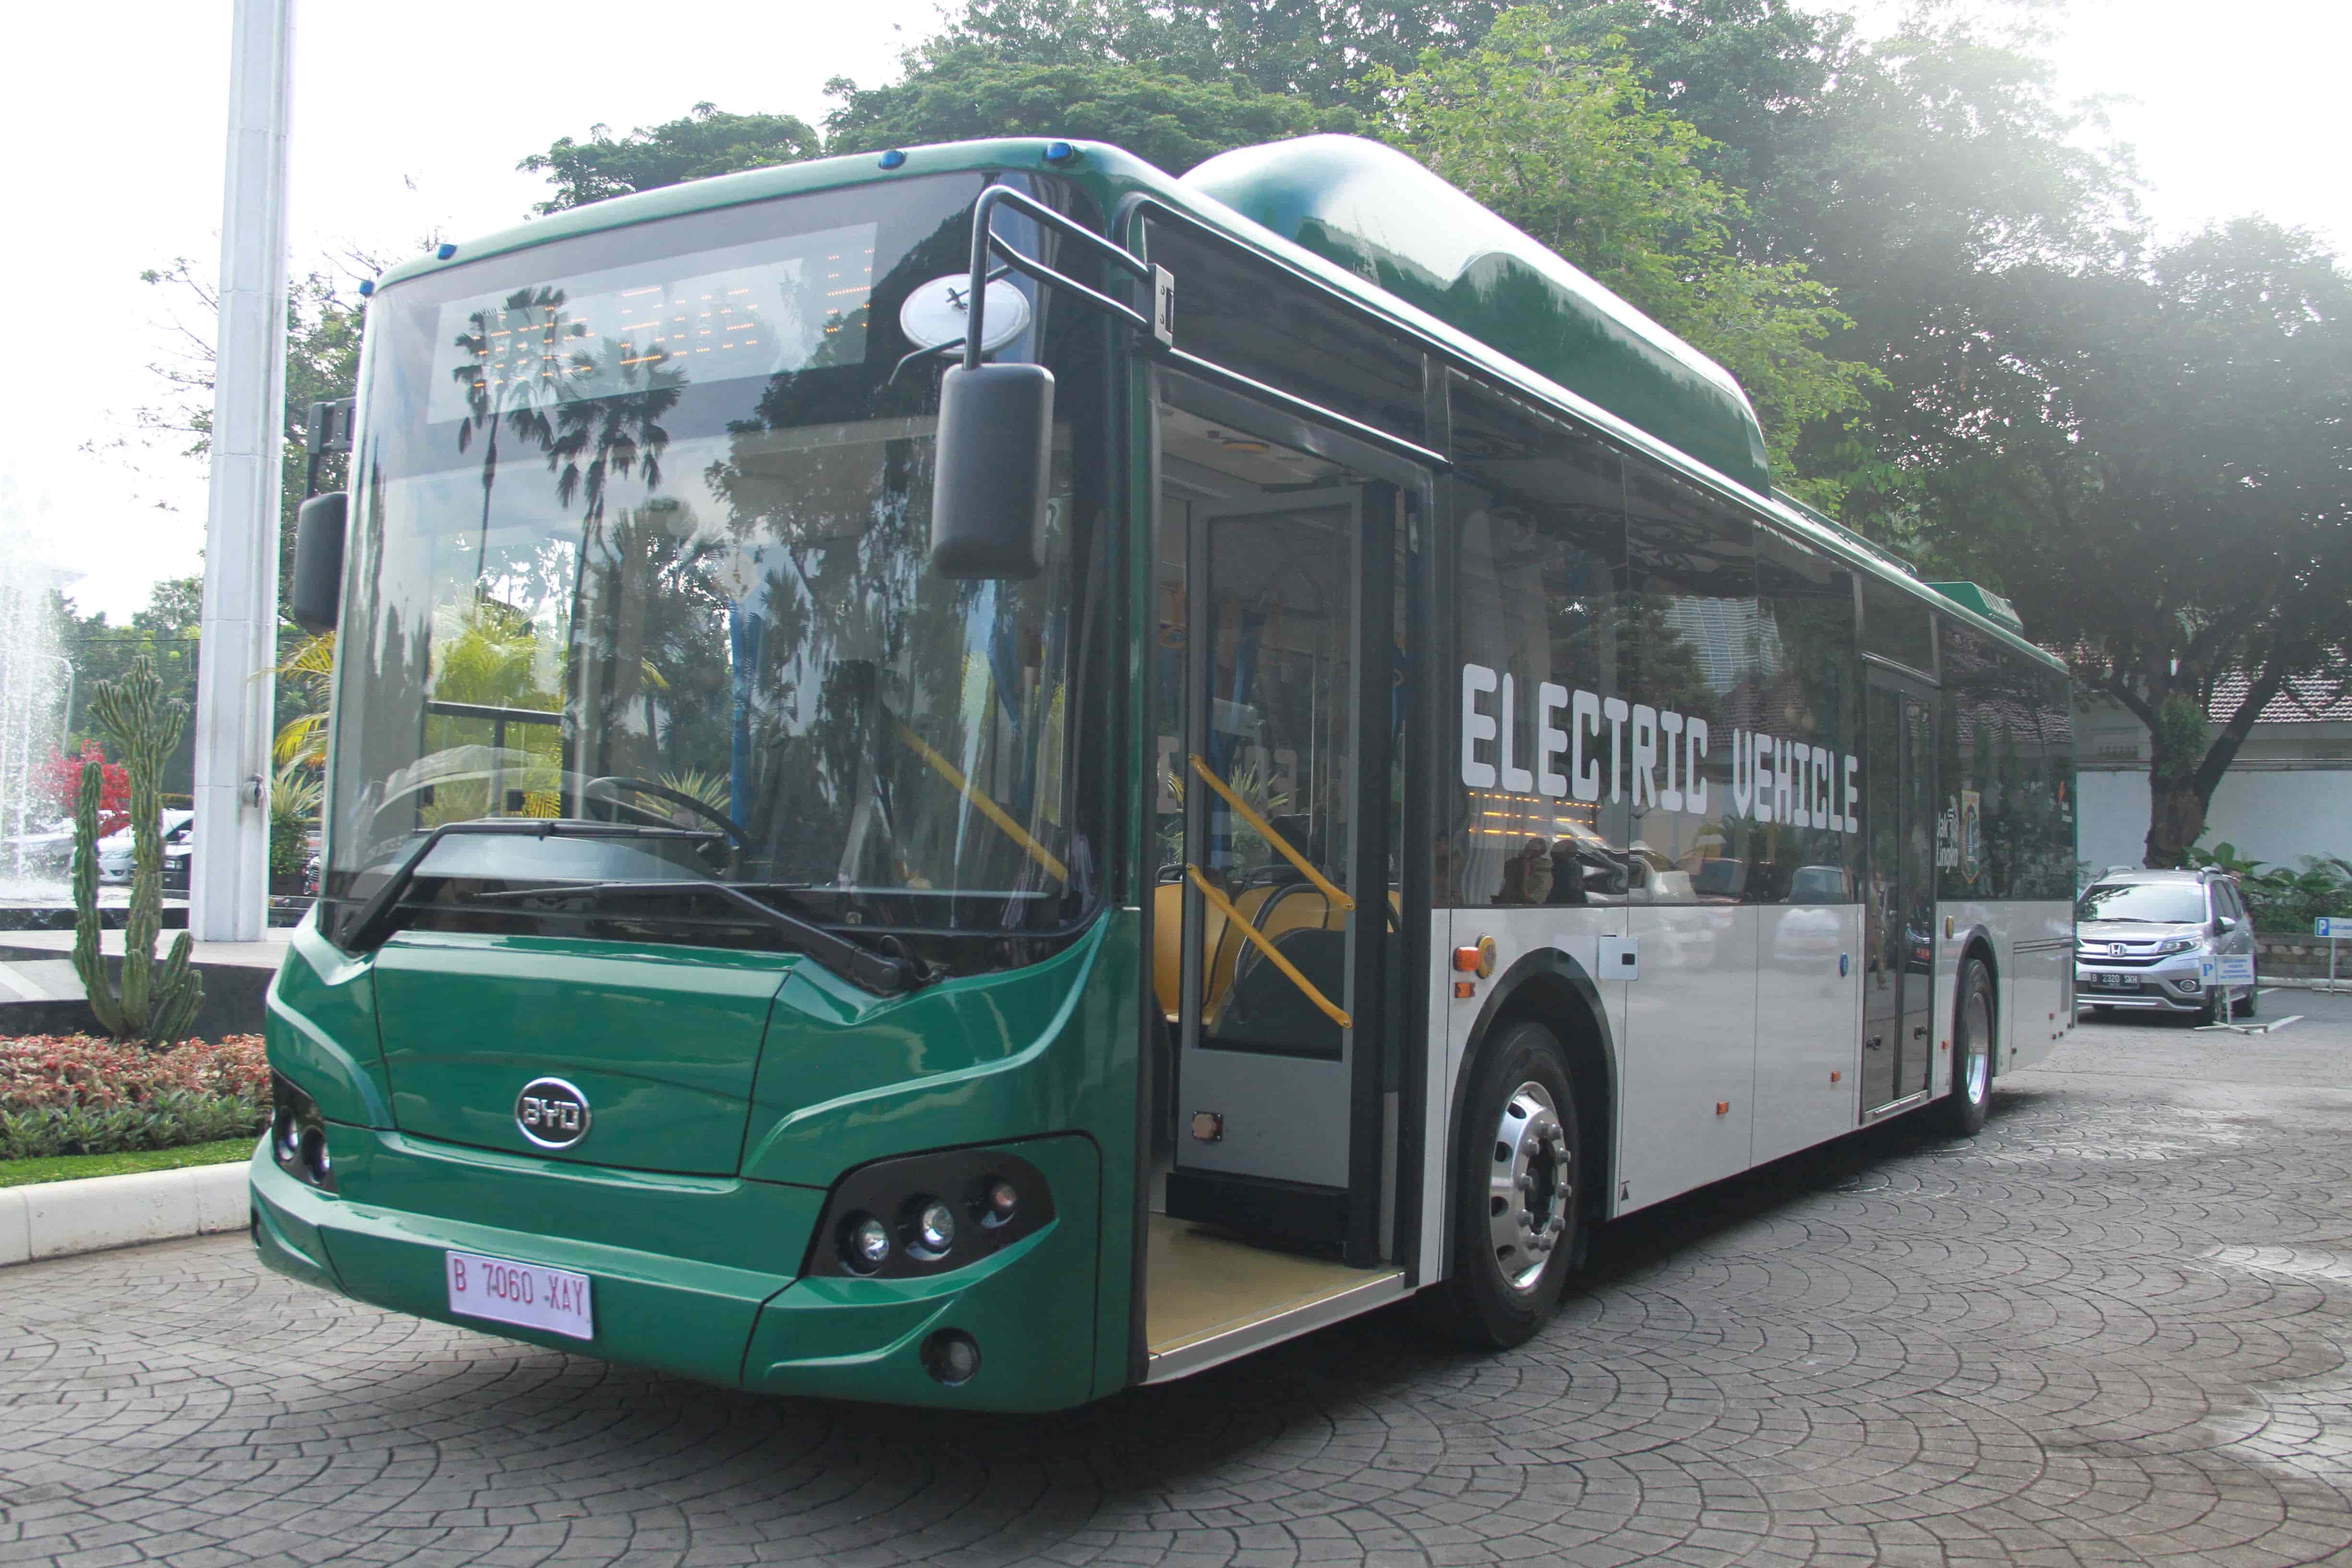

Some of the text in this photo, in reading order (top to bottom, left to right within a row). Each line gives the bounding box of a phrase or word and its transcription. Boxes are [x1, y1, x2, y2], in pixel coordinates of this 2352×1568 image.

[1462, 663, 1708, 815] ELECTRIC
[1733, 728, 1858, 834] VEHICLE
[1937, 811, 1948, 838] Jak
[1936, 841, 1958, 874] Lingko
[2318, 920, 2327, 935] P
[2092, 973, 2097, 982] B
[2203, 964, 2213, 976] P
[522, 1097, 580, 1130] BYD
[454, 1258, 584, 1315] B 7060 XAY
